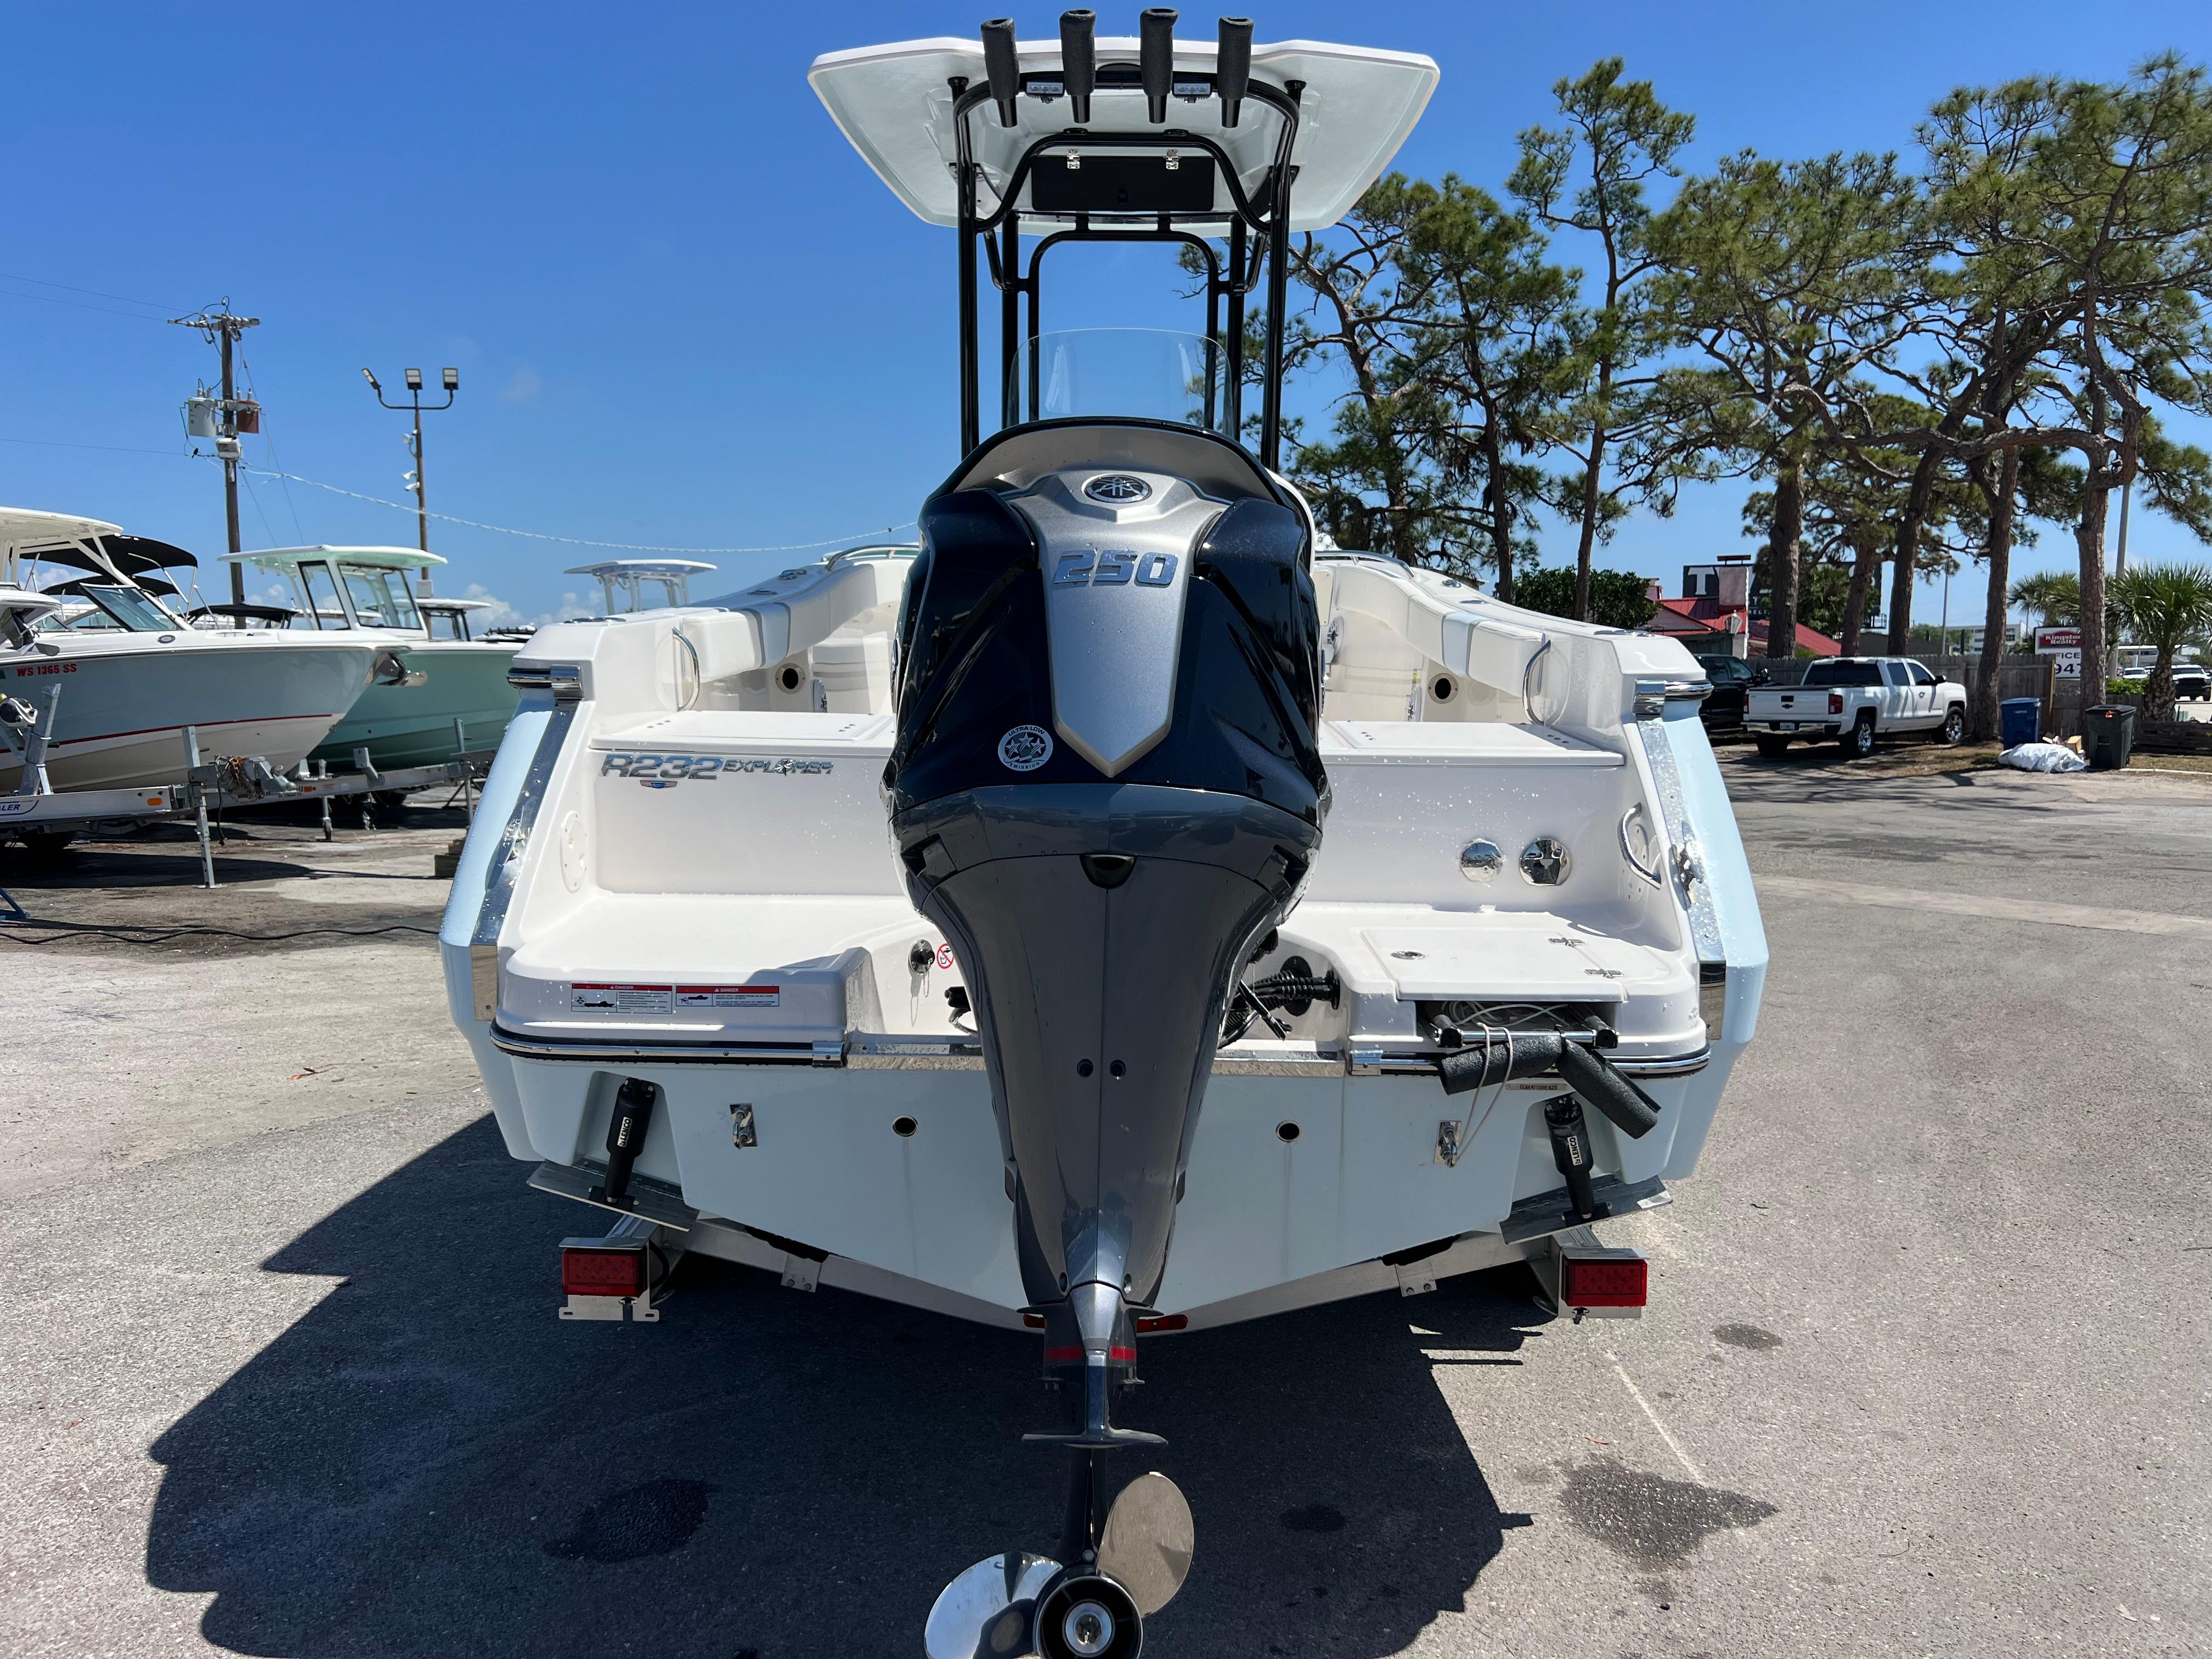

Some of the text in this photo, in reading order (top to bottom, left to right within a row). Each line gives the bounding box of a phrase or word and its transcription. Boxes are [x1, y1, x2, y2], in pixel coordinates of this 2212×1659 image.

[1054, 550, 1178, 585] 250
[17, 663, 77, 677] WS 1365 SS
[600, 754, 834, 780] R232 EXPLORER
[620, 1119, 631, 1141] LENCO
[1569, 1137, 1580, 1159] LENCO
